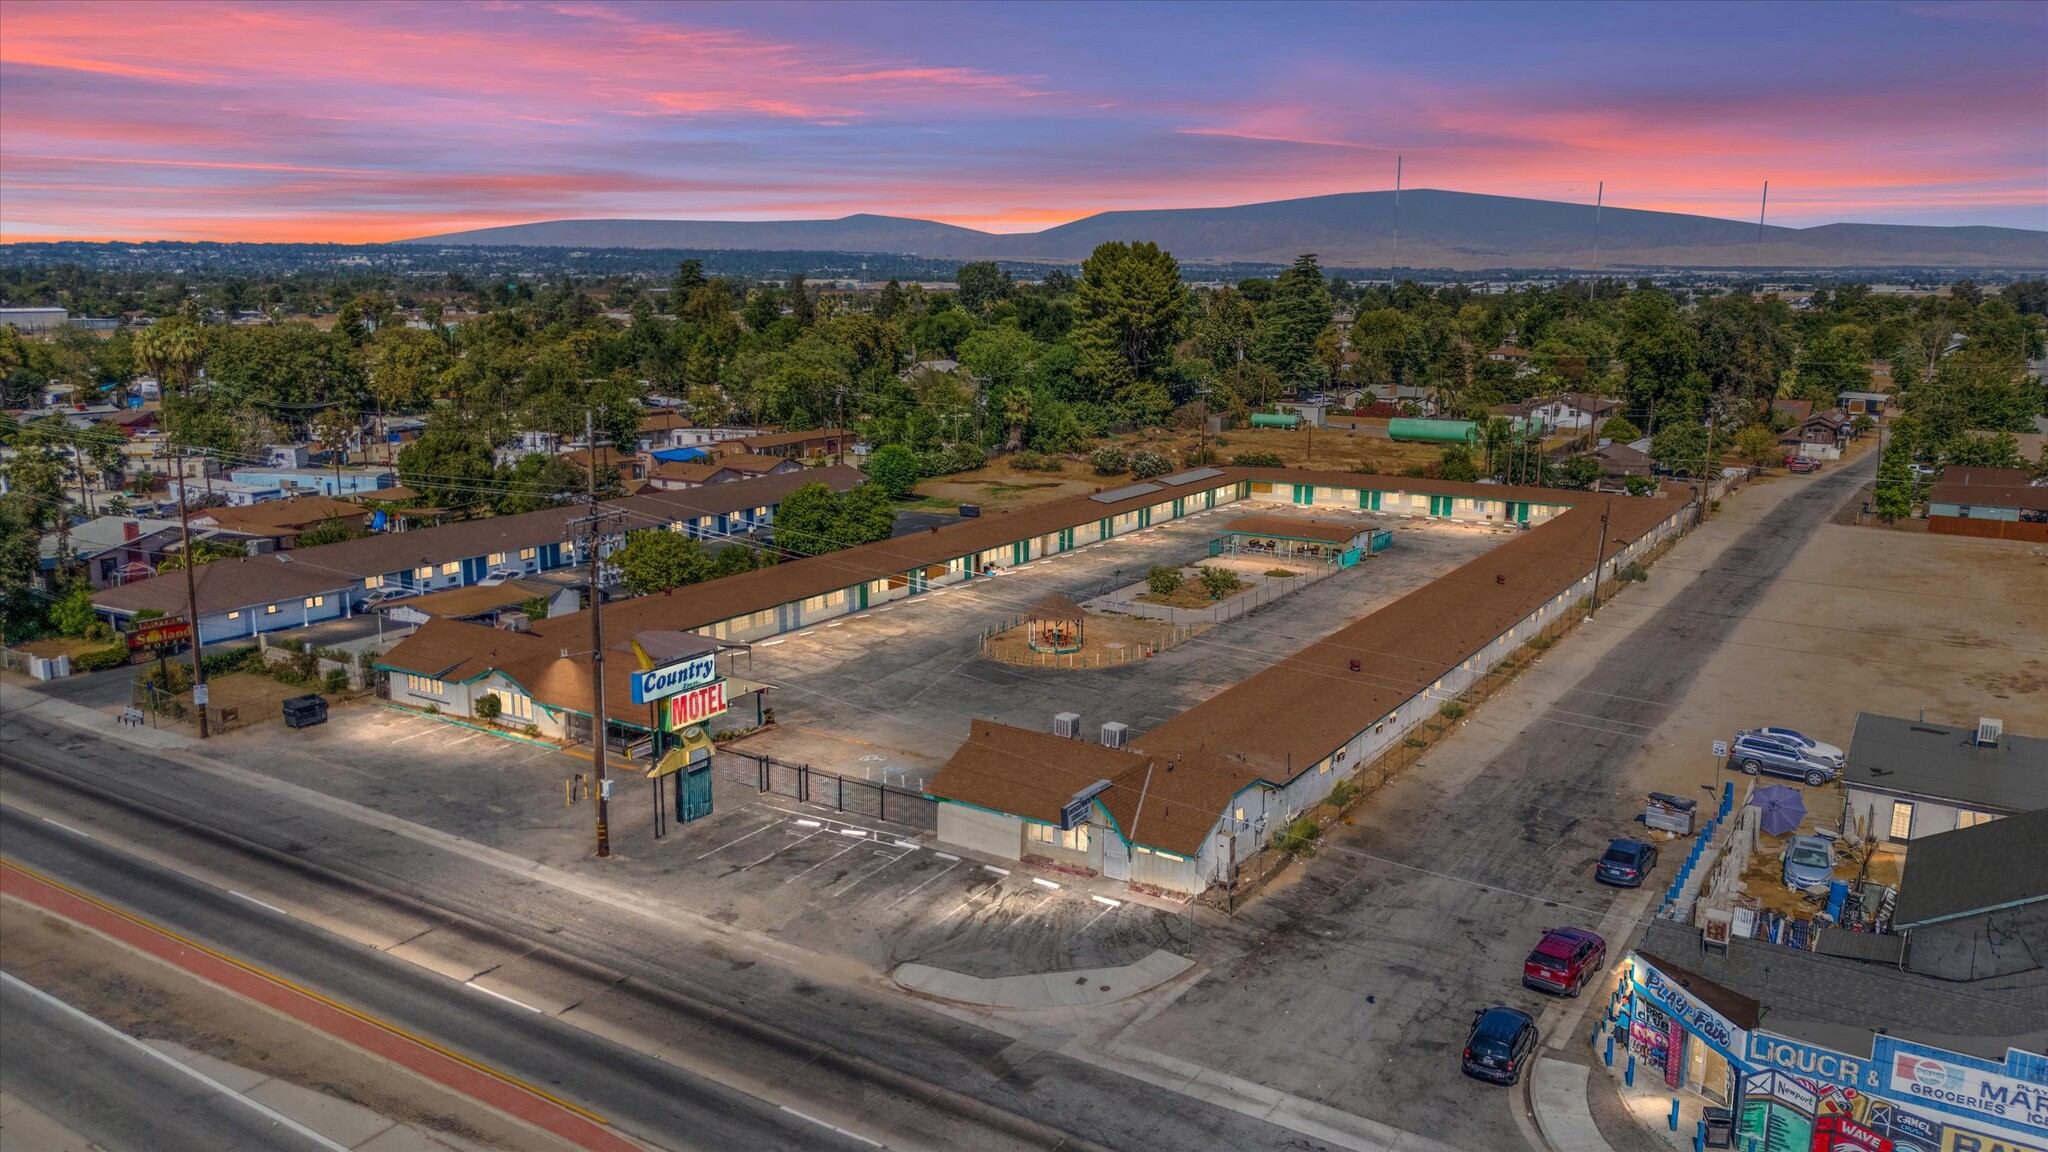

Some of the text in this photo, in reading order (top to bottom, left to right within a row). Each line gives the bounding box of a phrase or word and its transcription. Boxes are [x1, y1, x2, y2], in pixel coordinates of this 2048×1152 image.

[644, 659, 713, 693] Country
[672, 683, 726, 727] MOTEL
[1714, 747, 1725, 755] 25
[1645, 969, 1687, 1014] PLAY
[1638, 1011, 1669, 1032] CLUB
[1646, 1006, 1663, 1020] PRO
[1751, 1036, 1879, 1087] LIQUOR &
[1917, 1067, 1945, 1079] PEPSI
[1778, 1080, 1814, 1106] Newport
[1911, 1083, 2006, 1115] GROCERIES
[1842, 1121, 1881, 1148] WAVE
[1897, 1115, 1933, 1136] CAMEL
[1900, 1124, 1924, 1137] CRUSH
